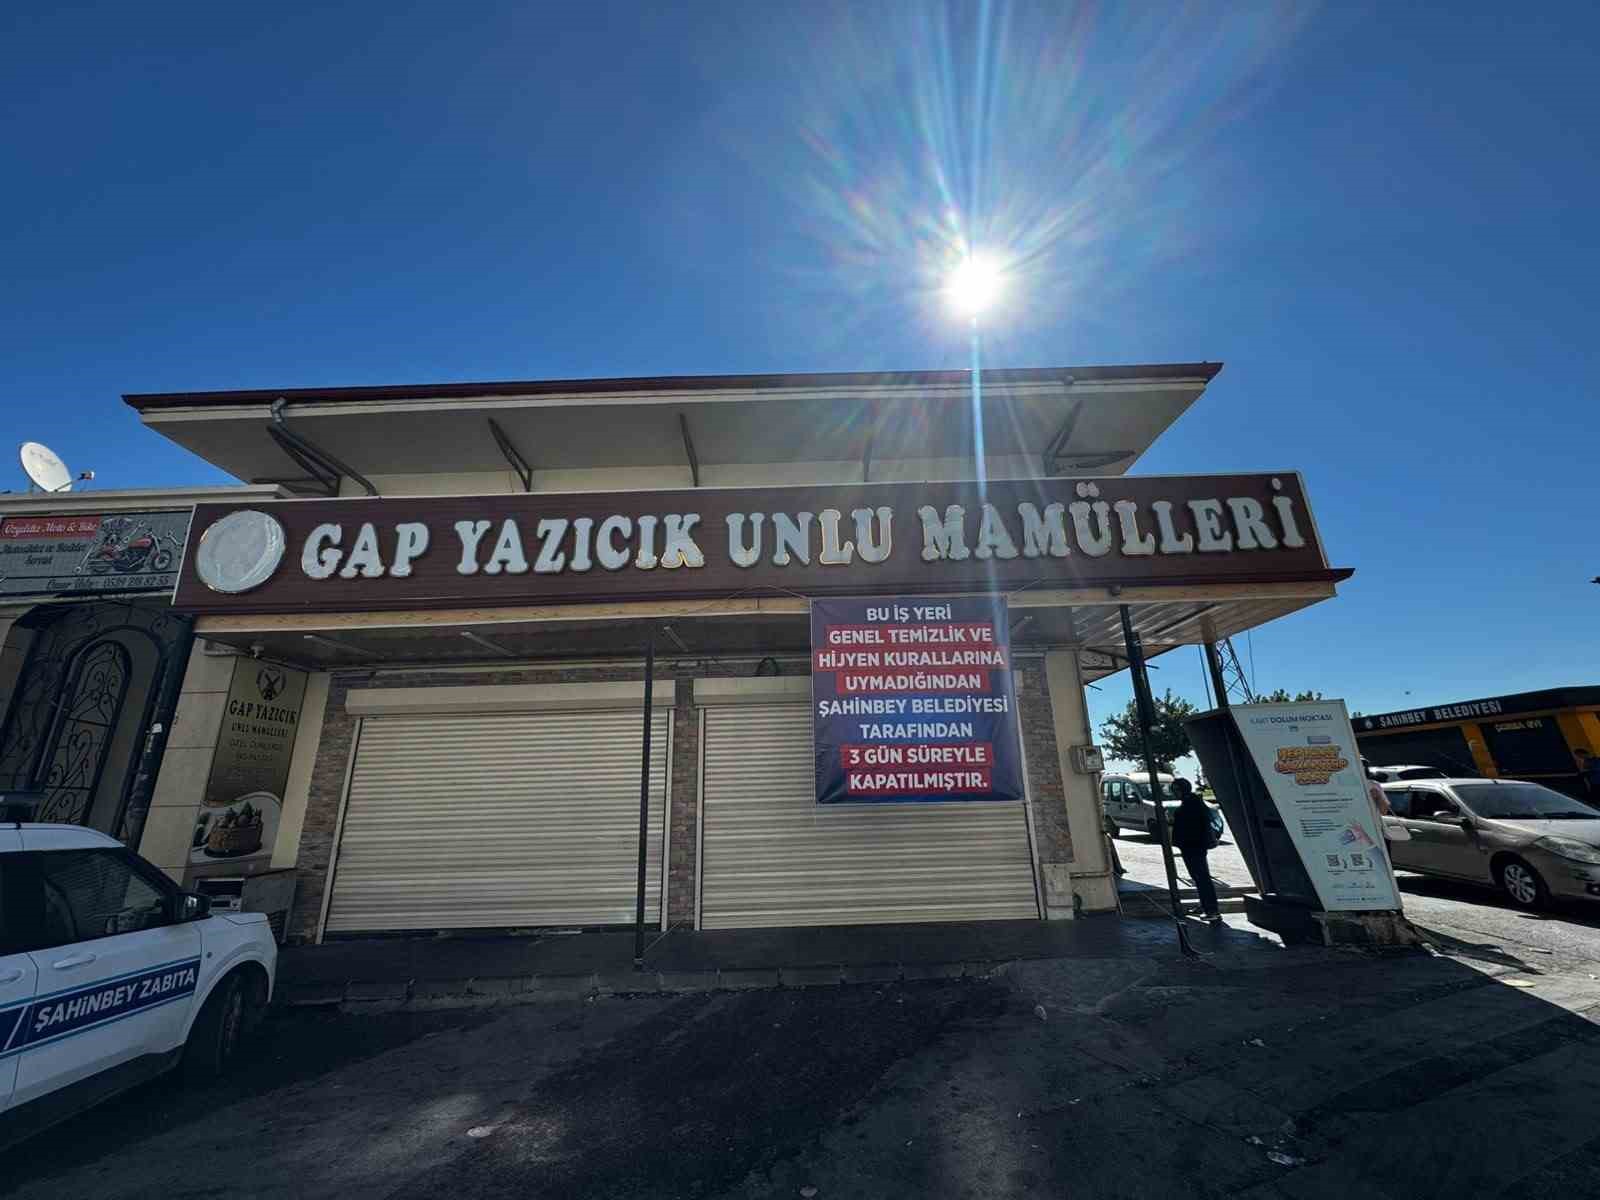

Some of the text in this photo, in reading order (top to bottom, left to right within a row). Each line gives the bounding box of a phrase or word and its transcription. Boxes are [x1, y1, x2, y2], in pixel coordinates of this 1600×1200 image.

[301, 477, 1306, 579] GAP YAZICIK UNLU MAMÜLLERİ
[866, 604, 952, 623] BU İŞ YERİ
[829, 626, 992, 645] GENEL TEMİZLİK VE
[819, 650, 1005, 667] HİJYEN KURALLARINA
[845, 672, 981, 690] UYMADIĞINDAN
[229, 700, 253, 717] GAP
[818, 696, 1009, 718] ŞAHİNBEY BELEDİYESİ
[859, 723, 973, 739] TARAFINDAN
[850, 745, 986, 764] 3 GÜN SÜREYLE
[850, 772, 988, 790] KAPATILMIŞTIR.
[35, 967, 195, 1032] ŞAHİNBEY ZABITA
